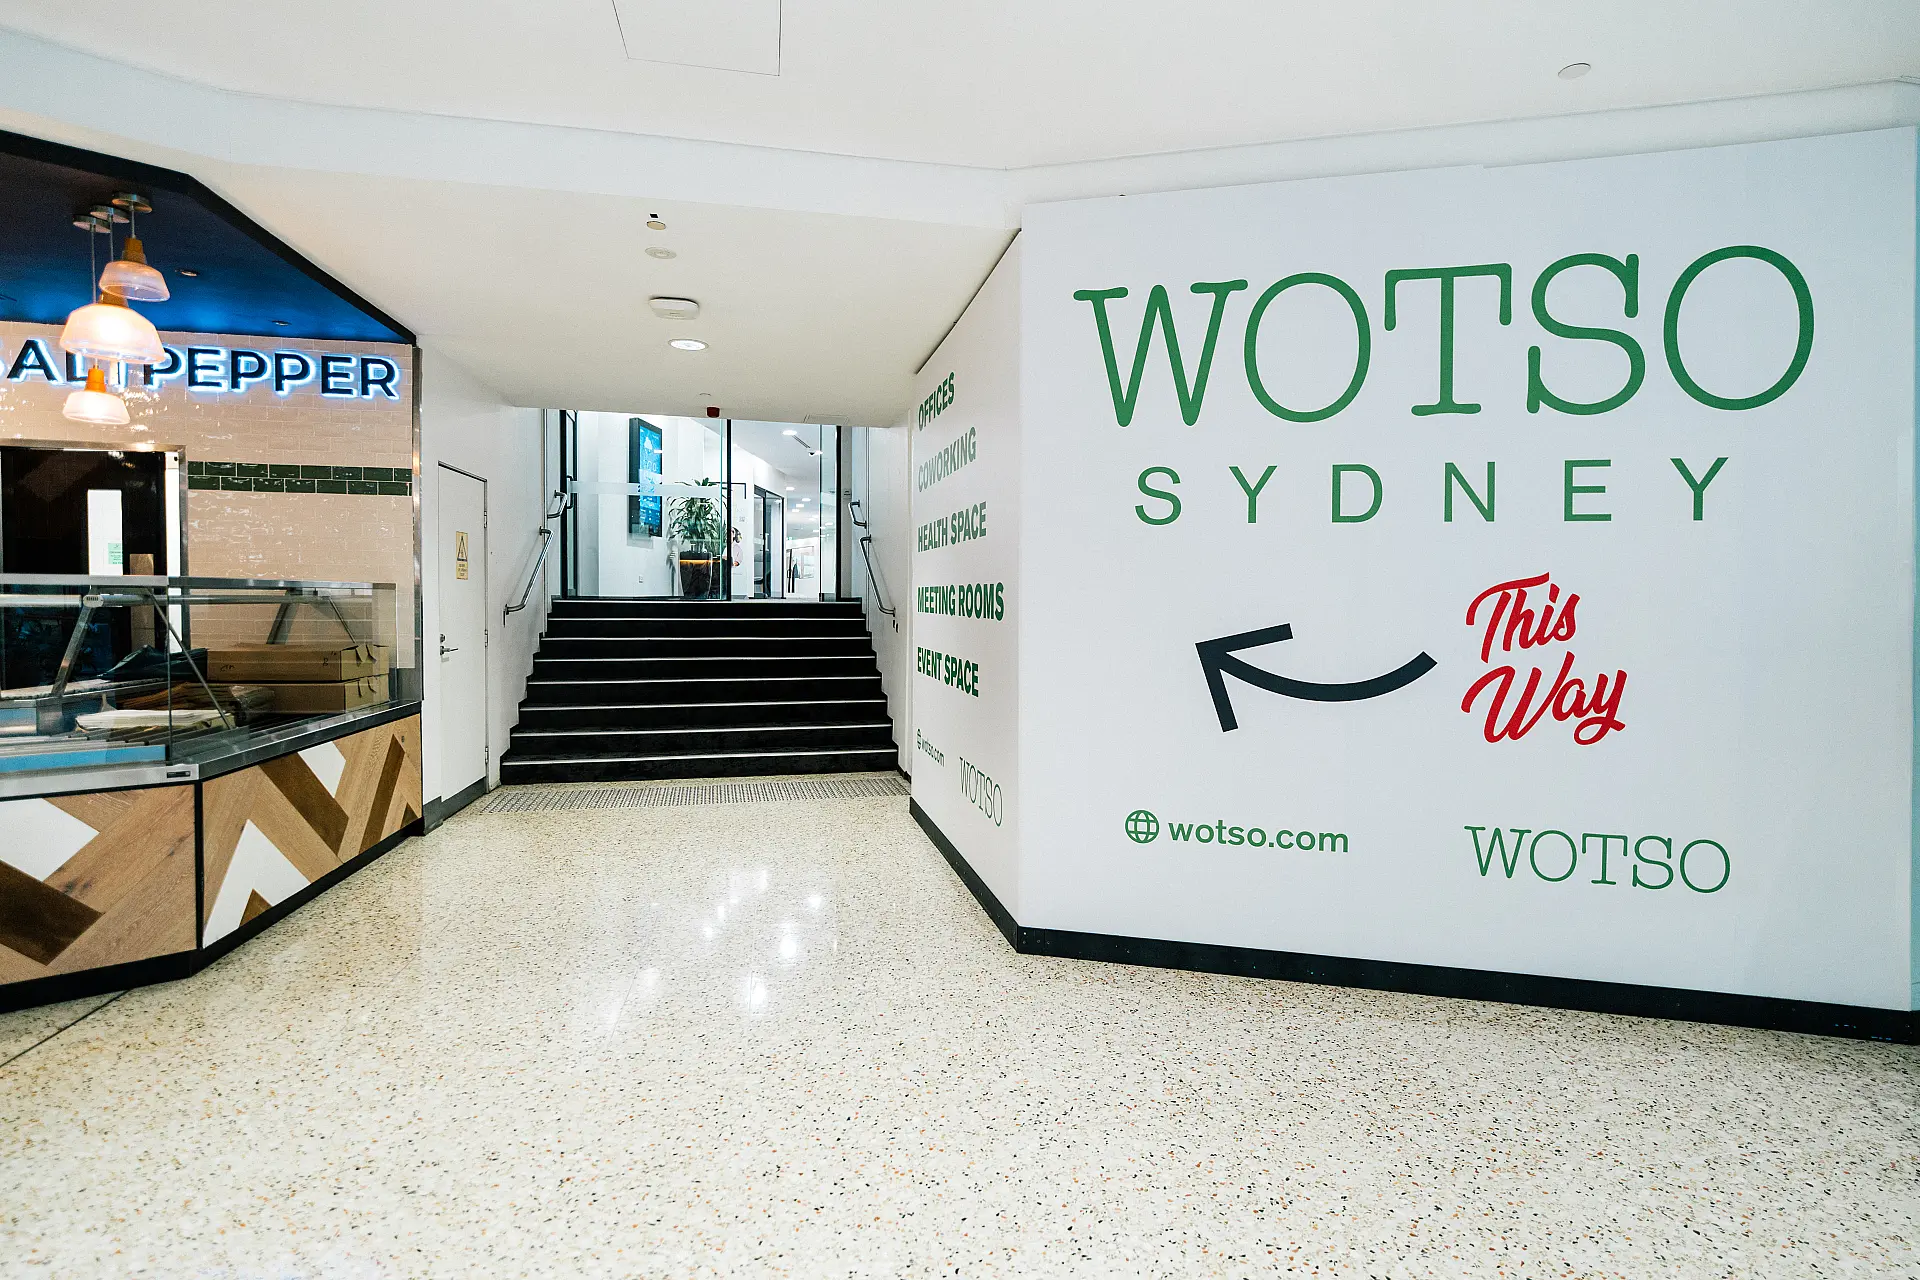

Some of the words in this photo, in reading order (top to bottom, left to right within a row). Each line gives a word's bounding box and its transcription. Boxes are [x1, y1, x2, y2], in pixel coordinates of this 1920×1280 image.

[1073, 244, 1816, 427] WOTSO
[918, 371, 955, 431] OFFICES
[918, 426, 977, 492] COWORKING
[1136, 456, 1729, 526] SYDNEY
[917, 516, 948, 552] HEALTH
[950, 501, 987, 545] SPACE
[917, 585, 956, 616] MEETING
[958, 582, 1004, 621] ROOMS
[1466, 572, 1580, 663] This
[917, 647, 942, 681] EVENT
[944, 656, 979, 697] SPACE
[1461, 651, 1628, 746] Way
[959, 756, 1003, 827] WOTSO
[1169, 819, 1350, 853] wotso.com
[1464, 825, 1732, 894] WOTSO
